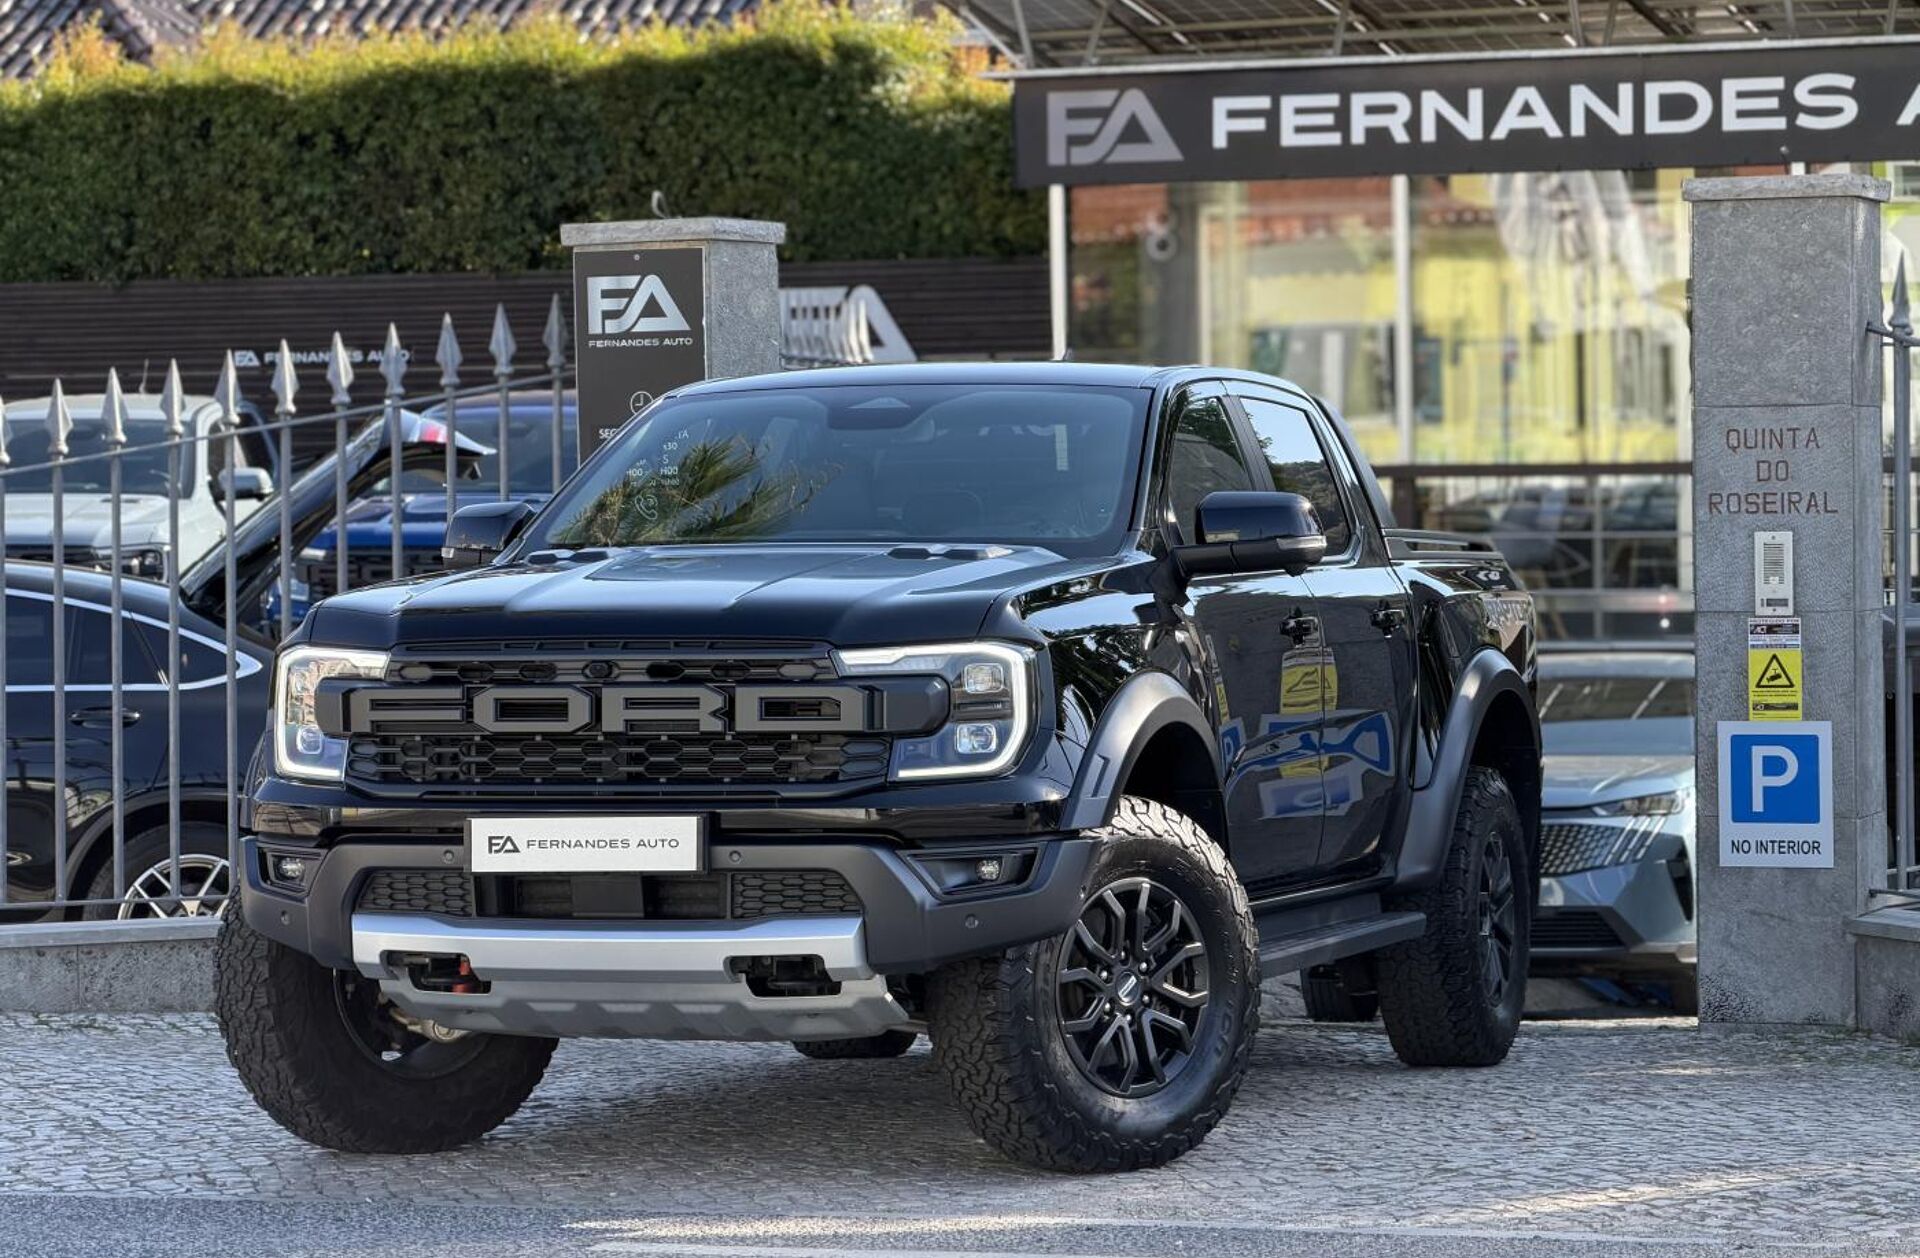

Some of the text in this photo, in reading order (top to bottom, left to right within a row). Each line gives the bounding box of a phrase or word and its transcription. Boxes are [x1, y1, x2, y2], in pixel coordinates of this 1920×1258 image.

[1046, 88, 1185, 166] FA
[1212, 72, 1859, 149] FERNANDES
[587, 274, 692, 335] FA
[588, 337, 693, 348] FERNANDES AUTO
[1726, 427, 1821, 454] QUINTA
[1756, 459, 1789, 482] DO
[1708, 491, 1839, 515] ROSEIRAL
[350, 683, 869, 734] FORD
[1751, 745, 1799, 812] P
[487, 835, 680, 854] FA FERNANDES AUTO
[1731, 839, 1822, 855] NO INTERIOR
